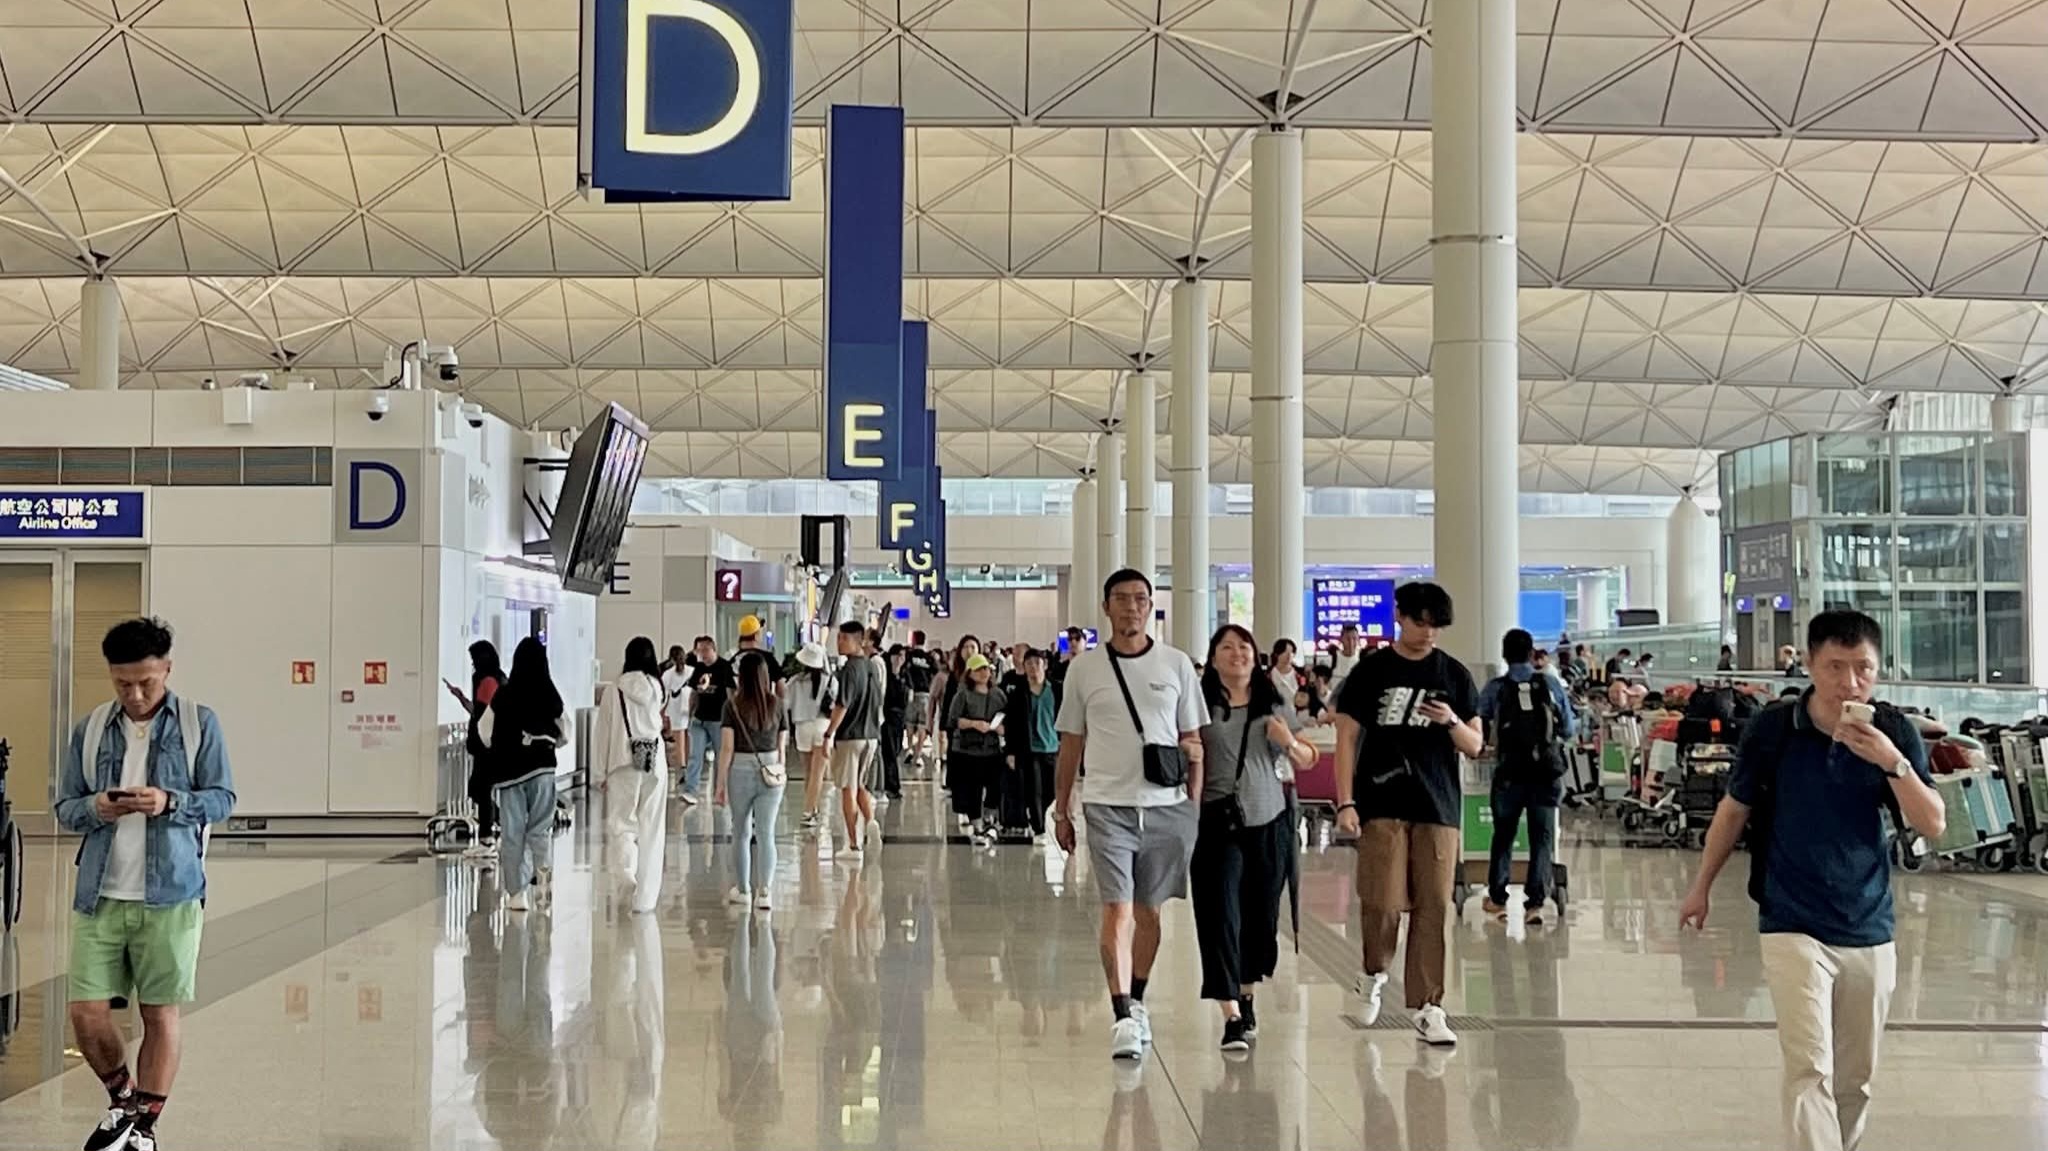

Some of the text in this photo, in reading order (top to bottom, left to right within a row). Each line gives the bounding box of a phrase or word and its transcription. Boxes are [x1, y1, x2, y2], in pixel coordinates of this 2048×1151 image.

[625, 0, 761, 155] D
[844, 404, 885, 468] E
[0, 498, 119, 517] 航空公司辦公室
[349, 461, 407, 530] D
[18, 516, 98, 530] Airline Office
[890, 502, 917, 543] F
[609, 562, 631, 594] E
